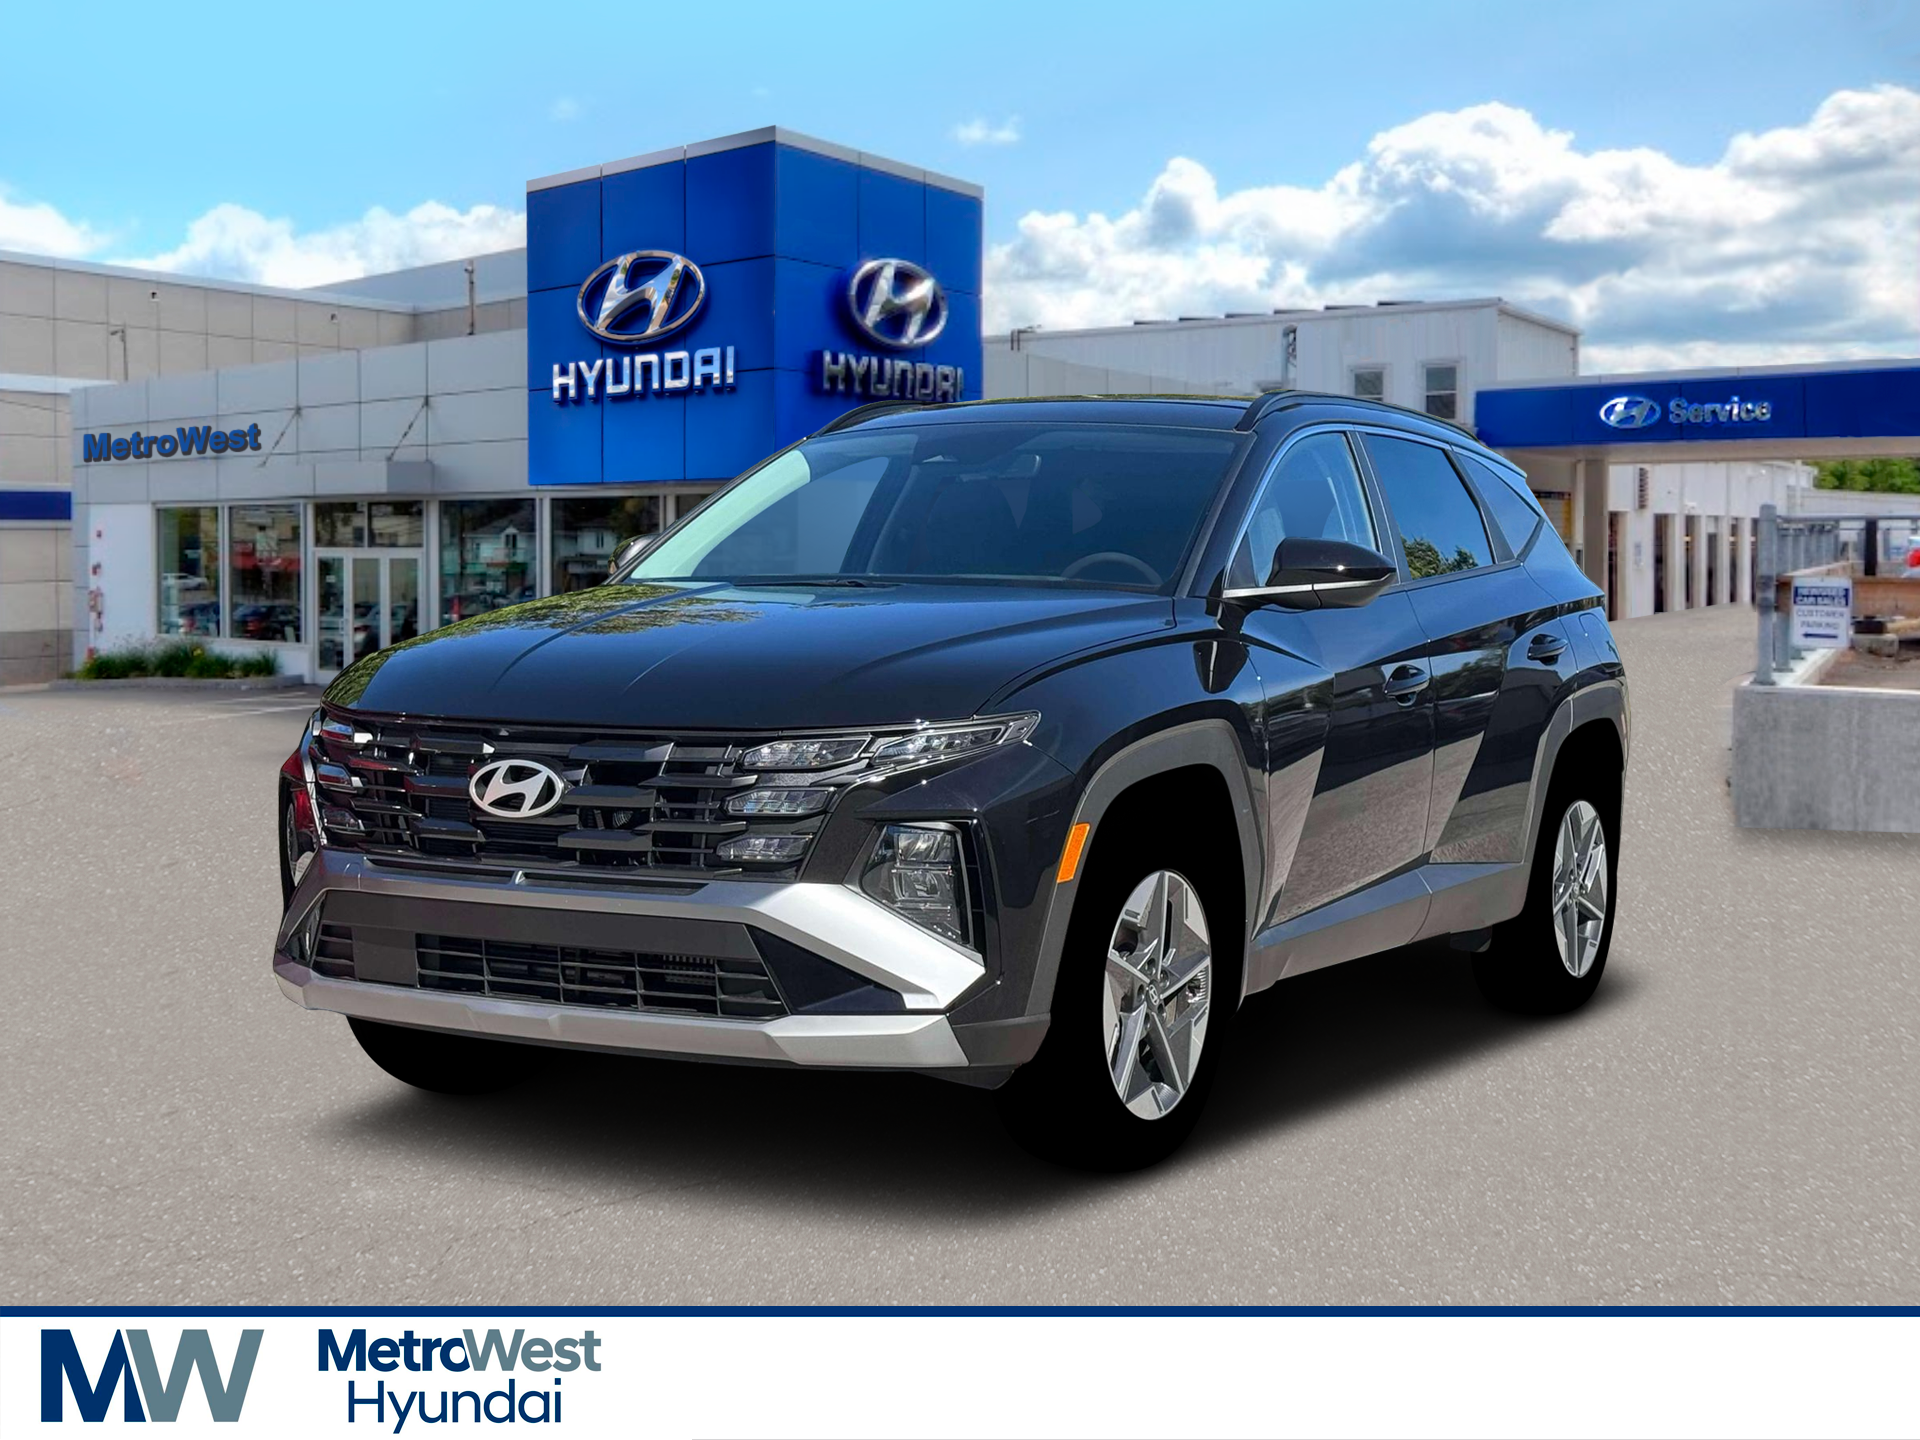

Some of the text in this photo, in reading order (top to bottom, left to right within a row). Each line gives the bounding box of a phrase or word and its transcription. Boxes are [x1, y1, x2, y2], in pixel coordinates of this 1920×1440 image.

[552, 345, 735, 403] HYUNDAI
[821, 349, 964, 403] HYUNDAI
[1668, 396, 1772, 424] Service
[83, 423, 262, 463] MetroWest
